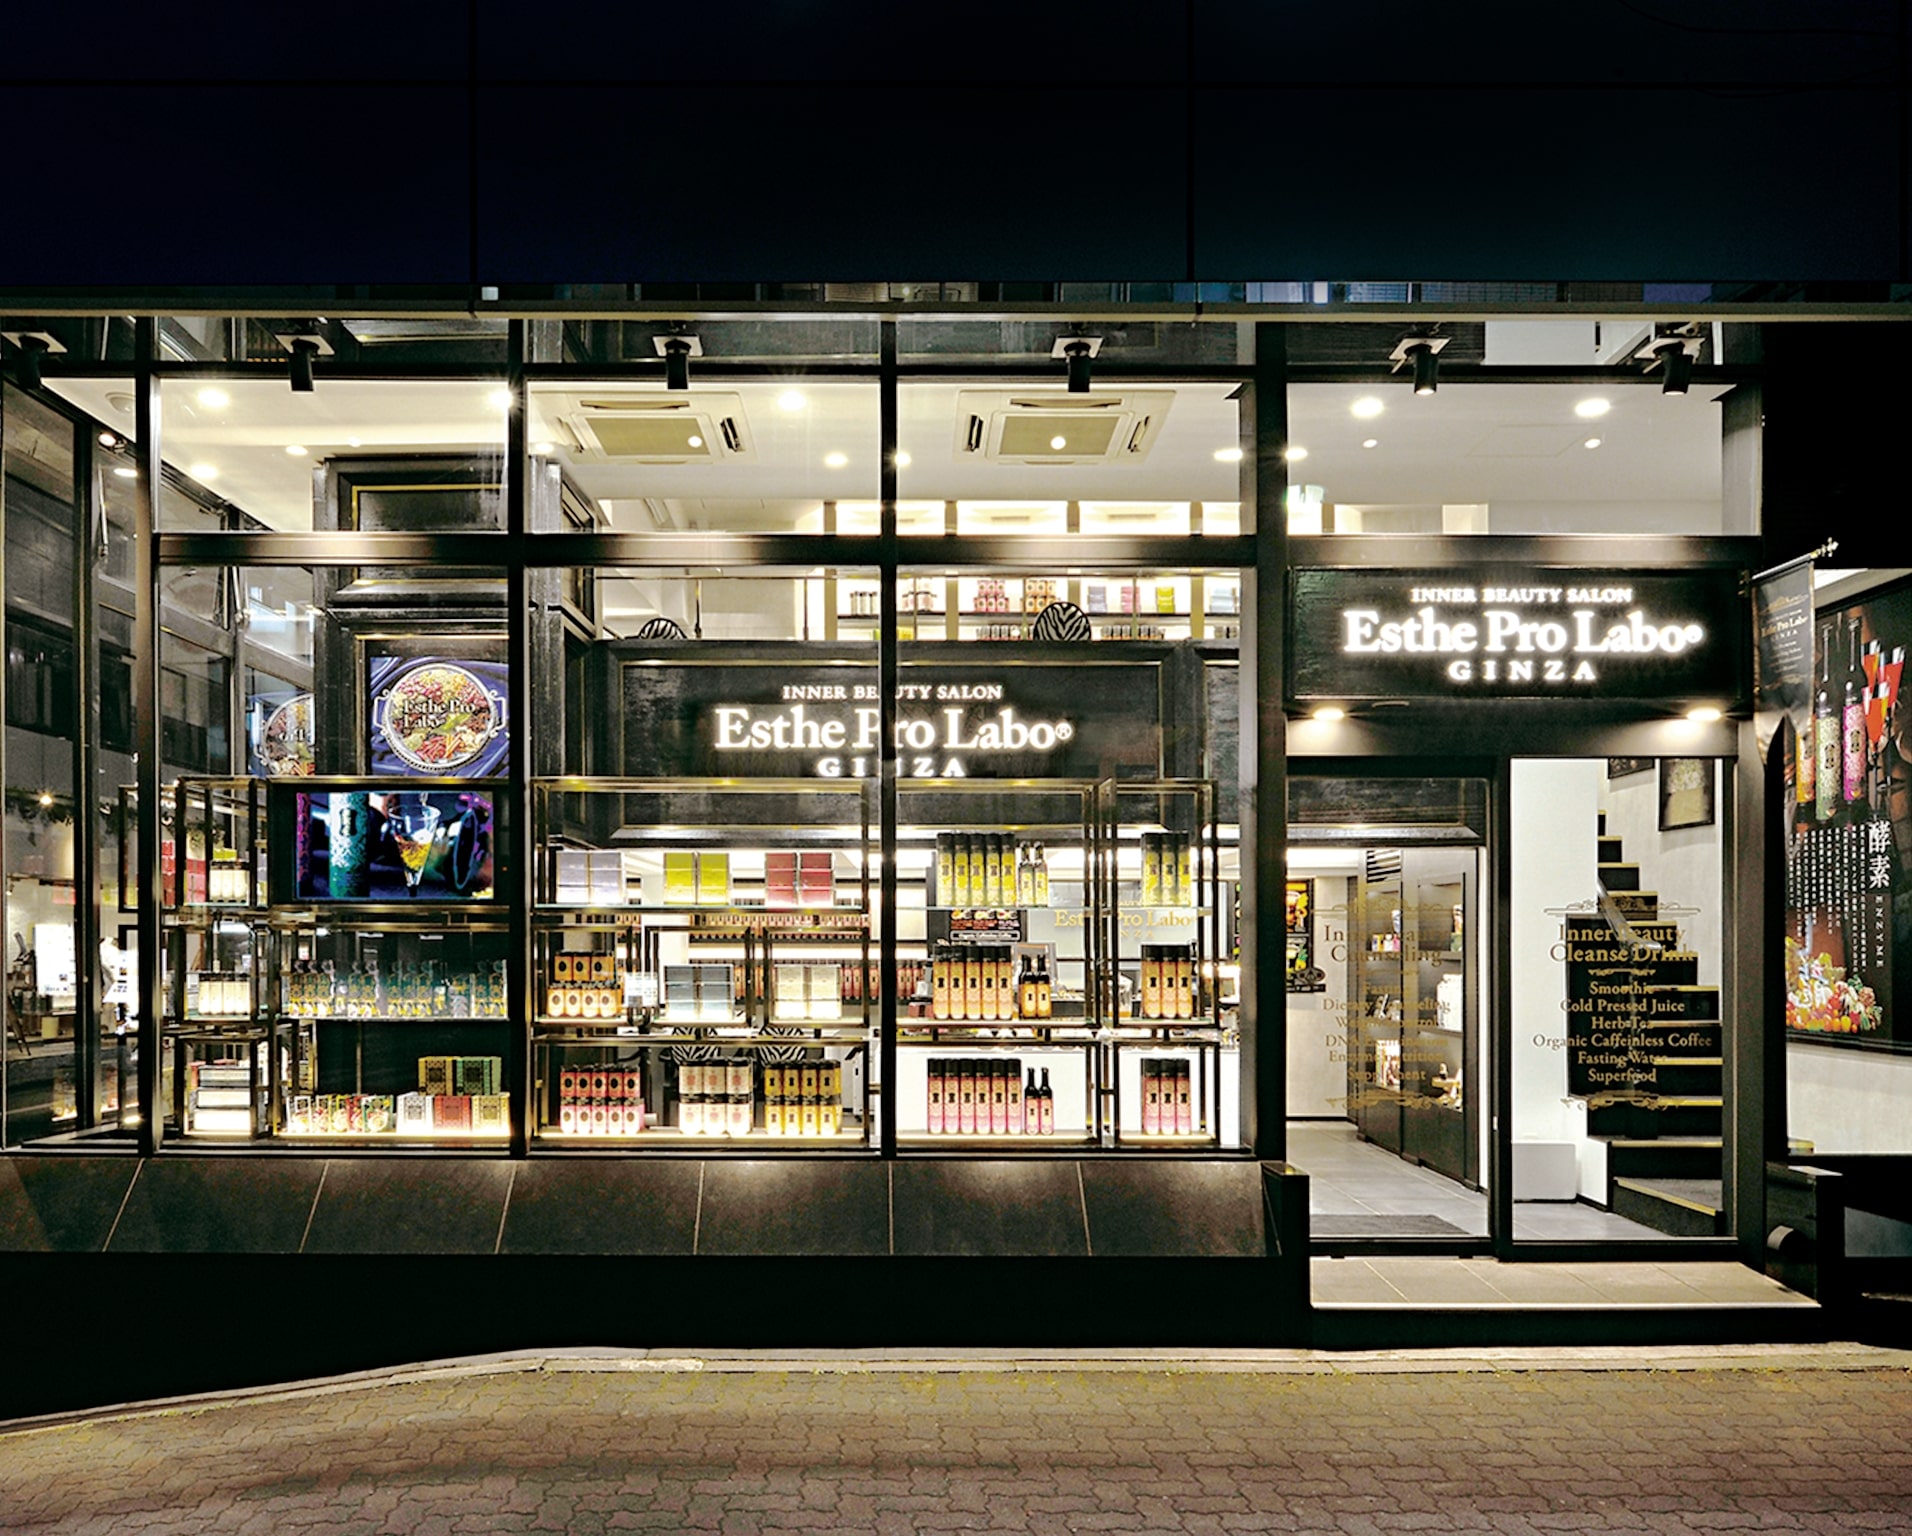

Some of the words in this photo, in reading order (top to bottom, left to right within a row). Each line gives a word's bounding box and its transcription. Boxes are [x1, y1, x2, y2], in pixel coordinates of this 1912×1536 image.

[1411, 588, 1477, 603] INNER
[1483, 588, 1562, 603] BEAUTY
[1566, 588, 1633, 603] SALON
[1343, 606, 1478, 653] Esthe
[1483, 609, 1567, 653] Pro
[1448, 660, 1597, 681] GINZA
[782, 685, 847, 700] INNER
[853, 685, 933, 700] BEUTY
[937, 685, 1003, 700] SALON
[713, 704, 845, 749] Esthe
[852, 708, 935, 749] Pro
[1867, 820, 1892, 889] 酵素
[1559, 924, 1614, 942] Inner
[1549, 943, 1629, 963] Cleanse
[1560, 999, 1593, 1013] Cold
[1597, 999, 1648, 1013] Pressed
[1650, 999, 1686, 1015] Juice
[1532, 1033, 1588, 1052] Organic
[1591, 1033, 1665, 1047] Caffeinless
[1667, 1033, 1713, 1047] Coffee
[1578, 1051, 1627, 1069] Fasting
[1587, 1067, 1657, 1085] Superfood
